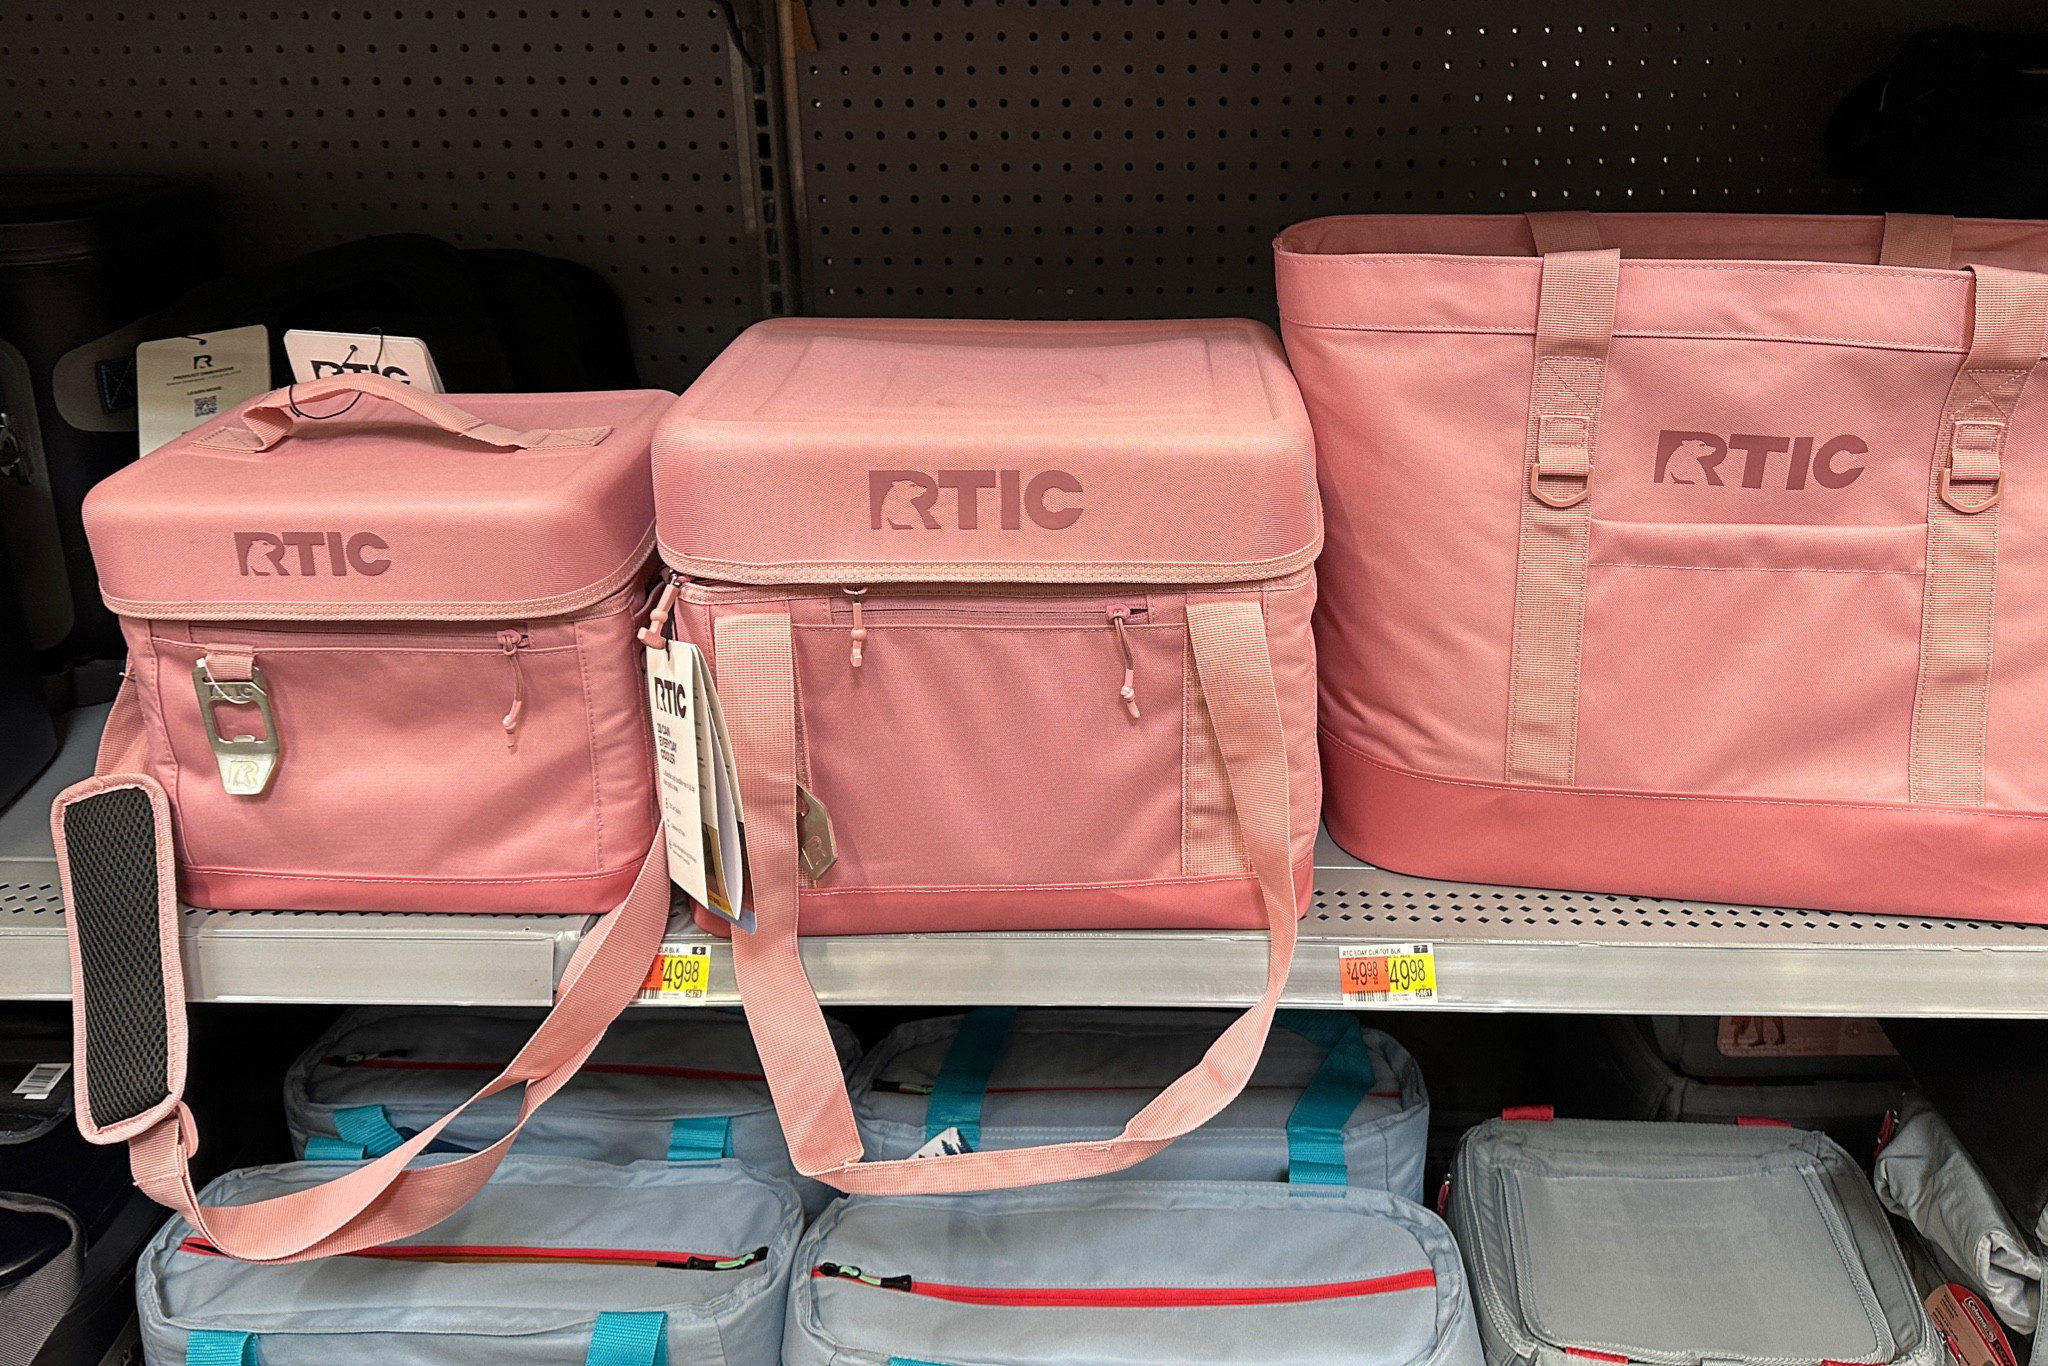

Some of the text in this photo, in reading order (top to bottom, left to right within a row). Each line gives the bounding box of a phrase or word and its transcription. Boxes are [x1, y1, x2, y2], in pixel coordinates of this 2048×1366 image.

[1653, 430, 1869, 490] RTIC
[869, 470, 1084, 530] RTIC
[234, 532, 391, 576] RTIC
[654, 677, 687, 718] RTIC
